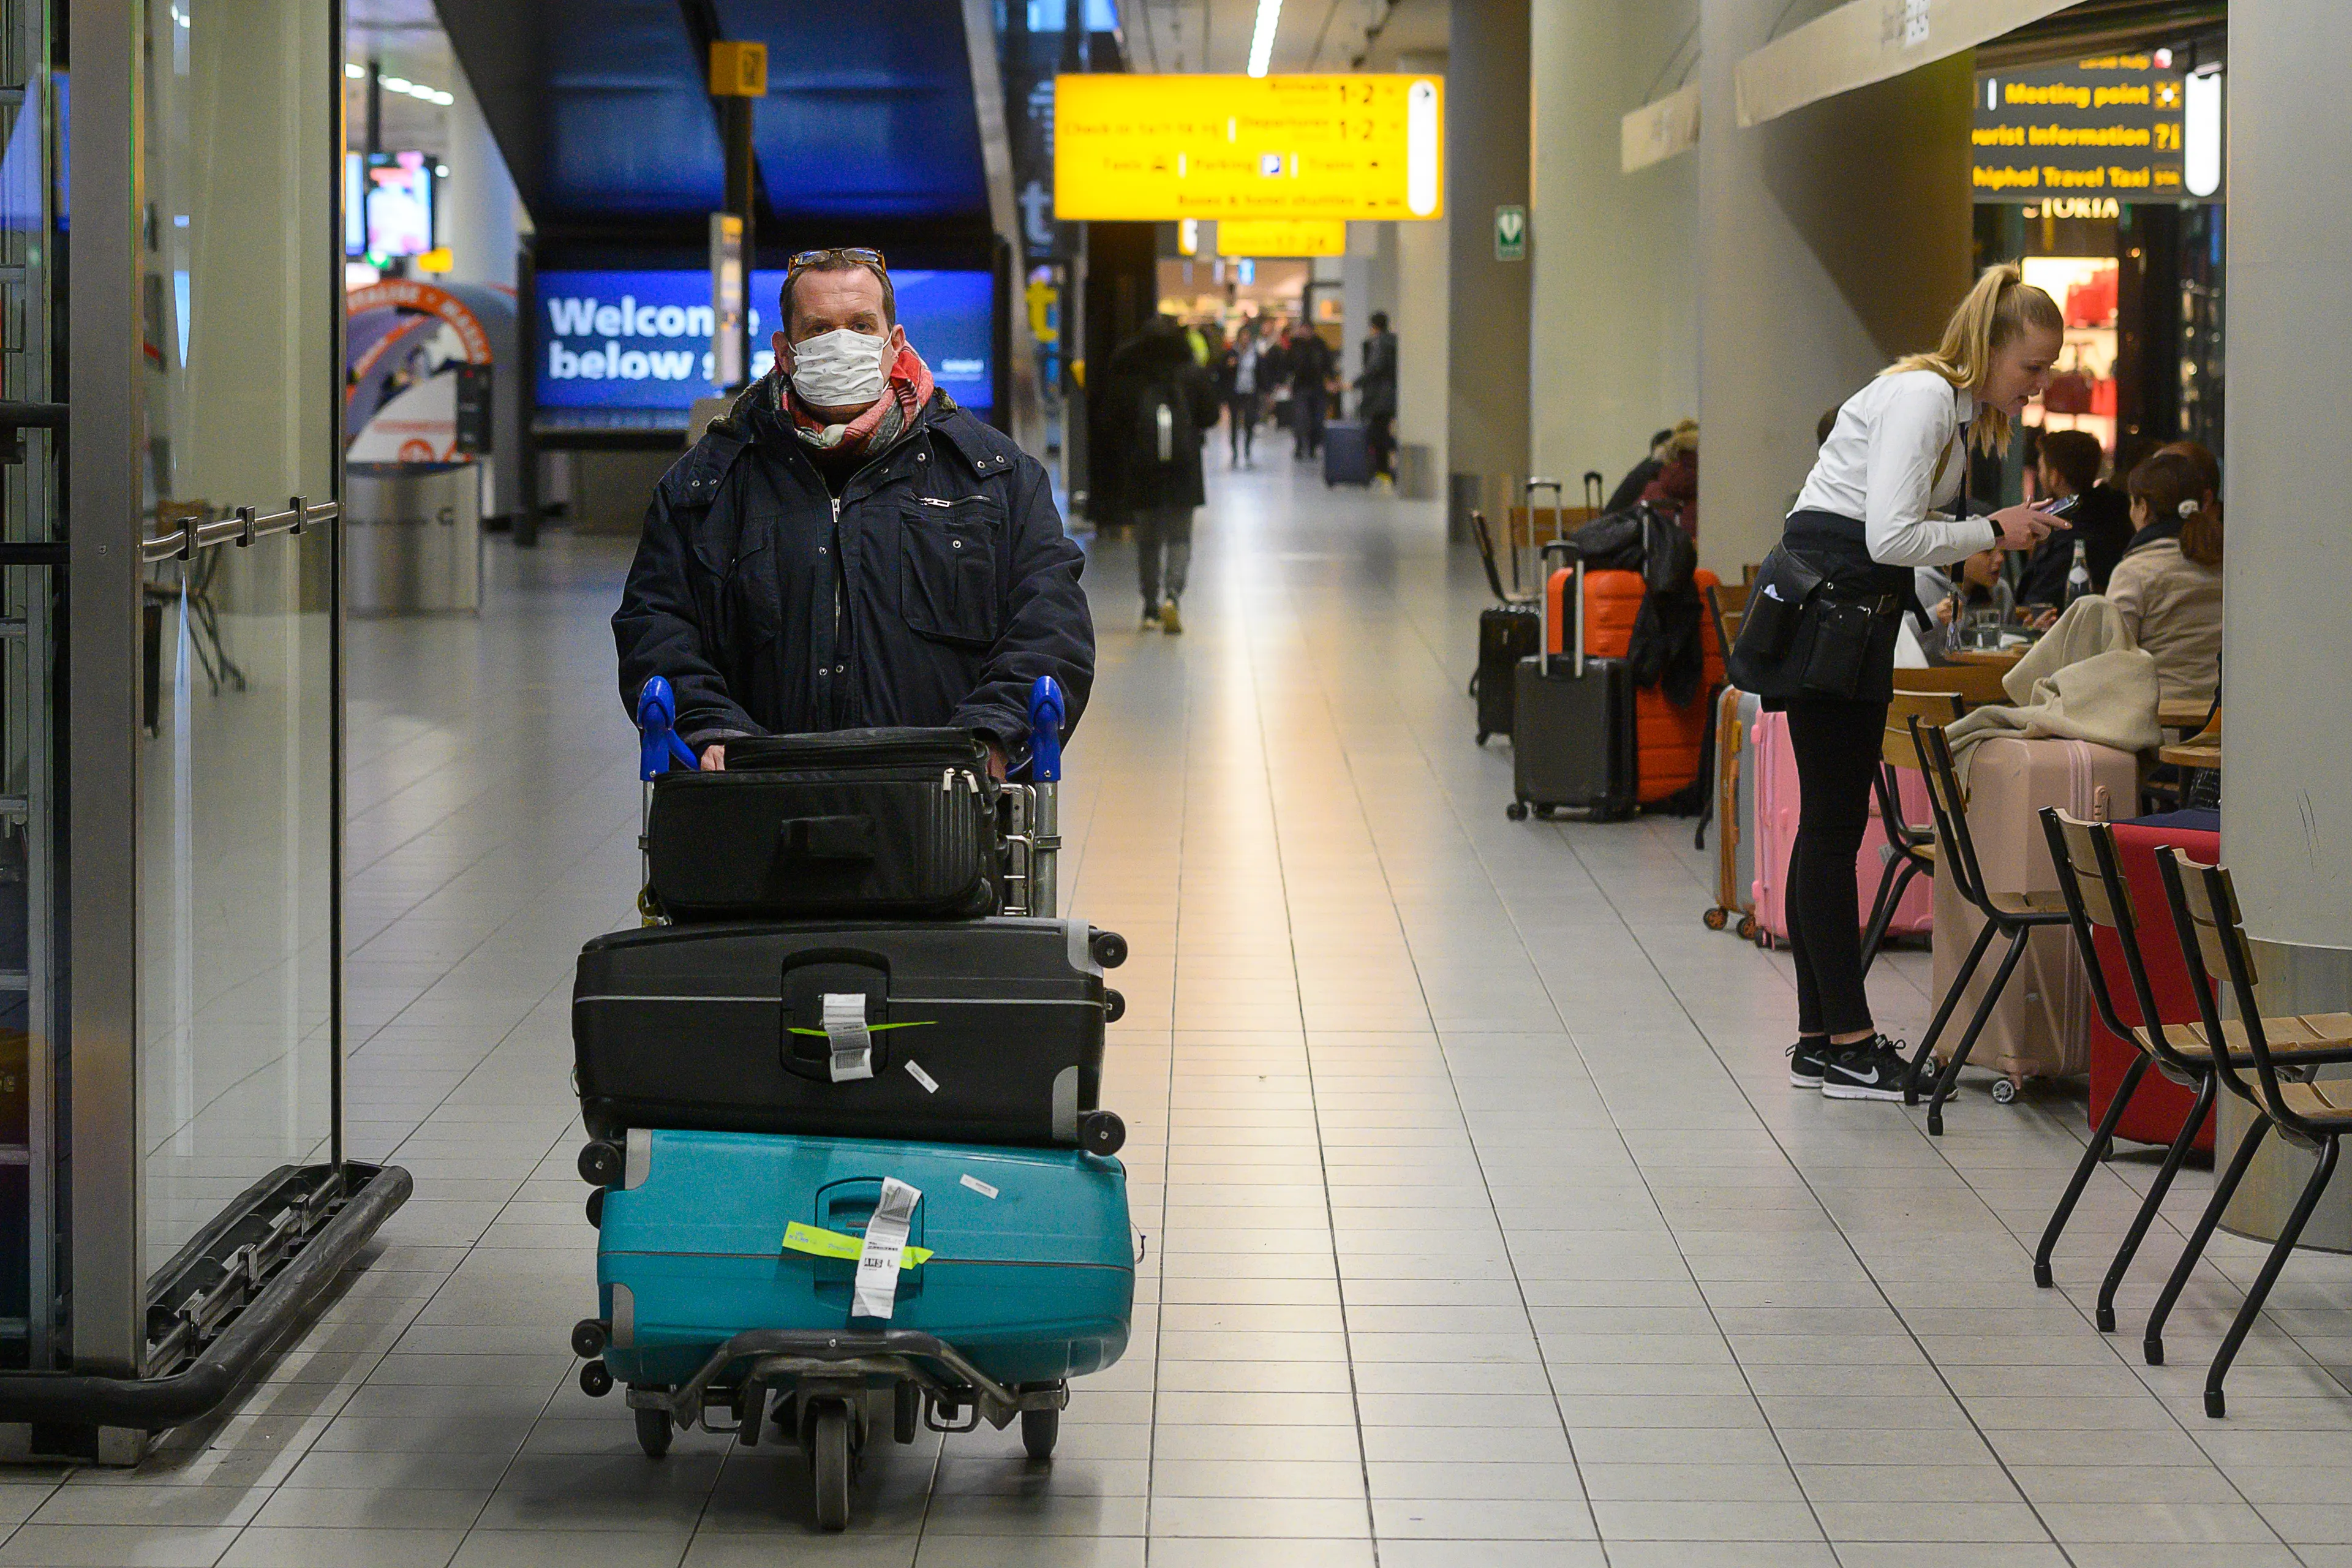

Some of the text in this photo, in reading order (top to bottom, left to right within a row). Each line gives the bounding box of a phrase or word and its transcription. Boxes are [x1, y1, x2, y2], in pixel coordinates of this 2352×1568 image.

[2005, 83, 2150, 108] Meeting point
[2028, 123, 2150, 146] Information
[1972, 165, 2039, 190] hiphol
[2042, 165, 2105, 188] Travel
[2107, 165, 2150, 188] Taxi
[548, 340, 695, 381] below
